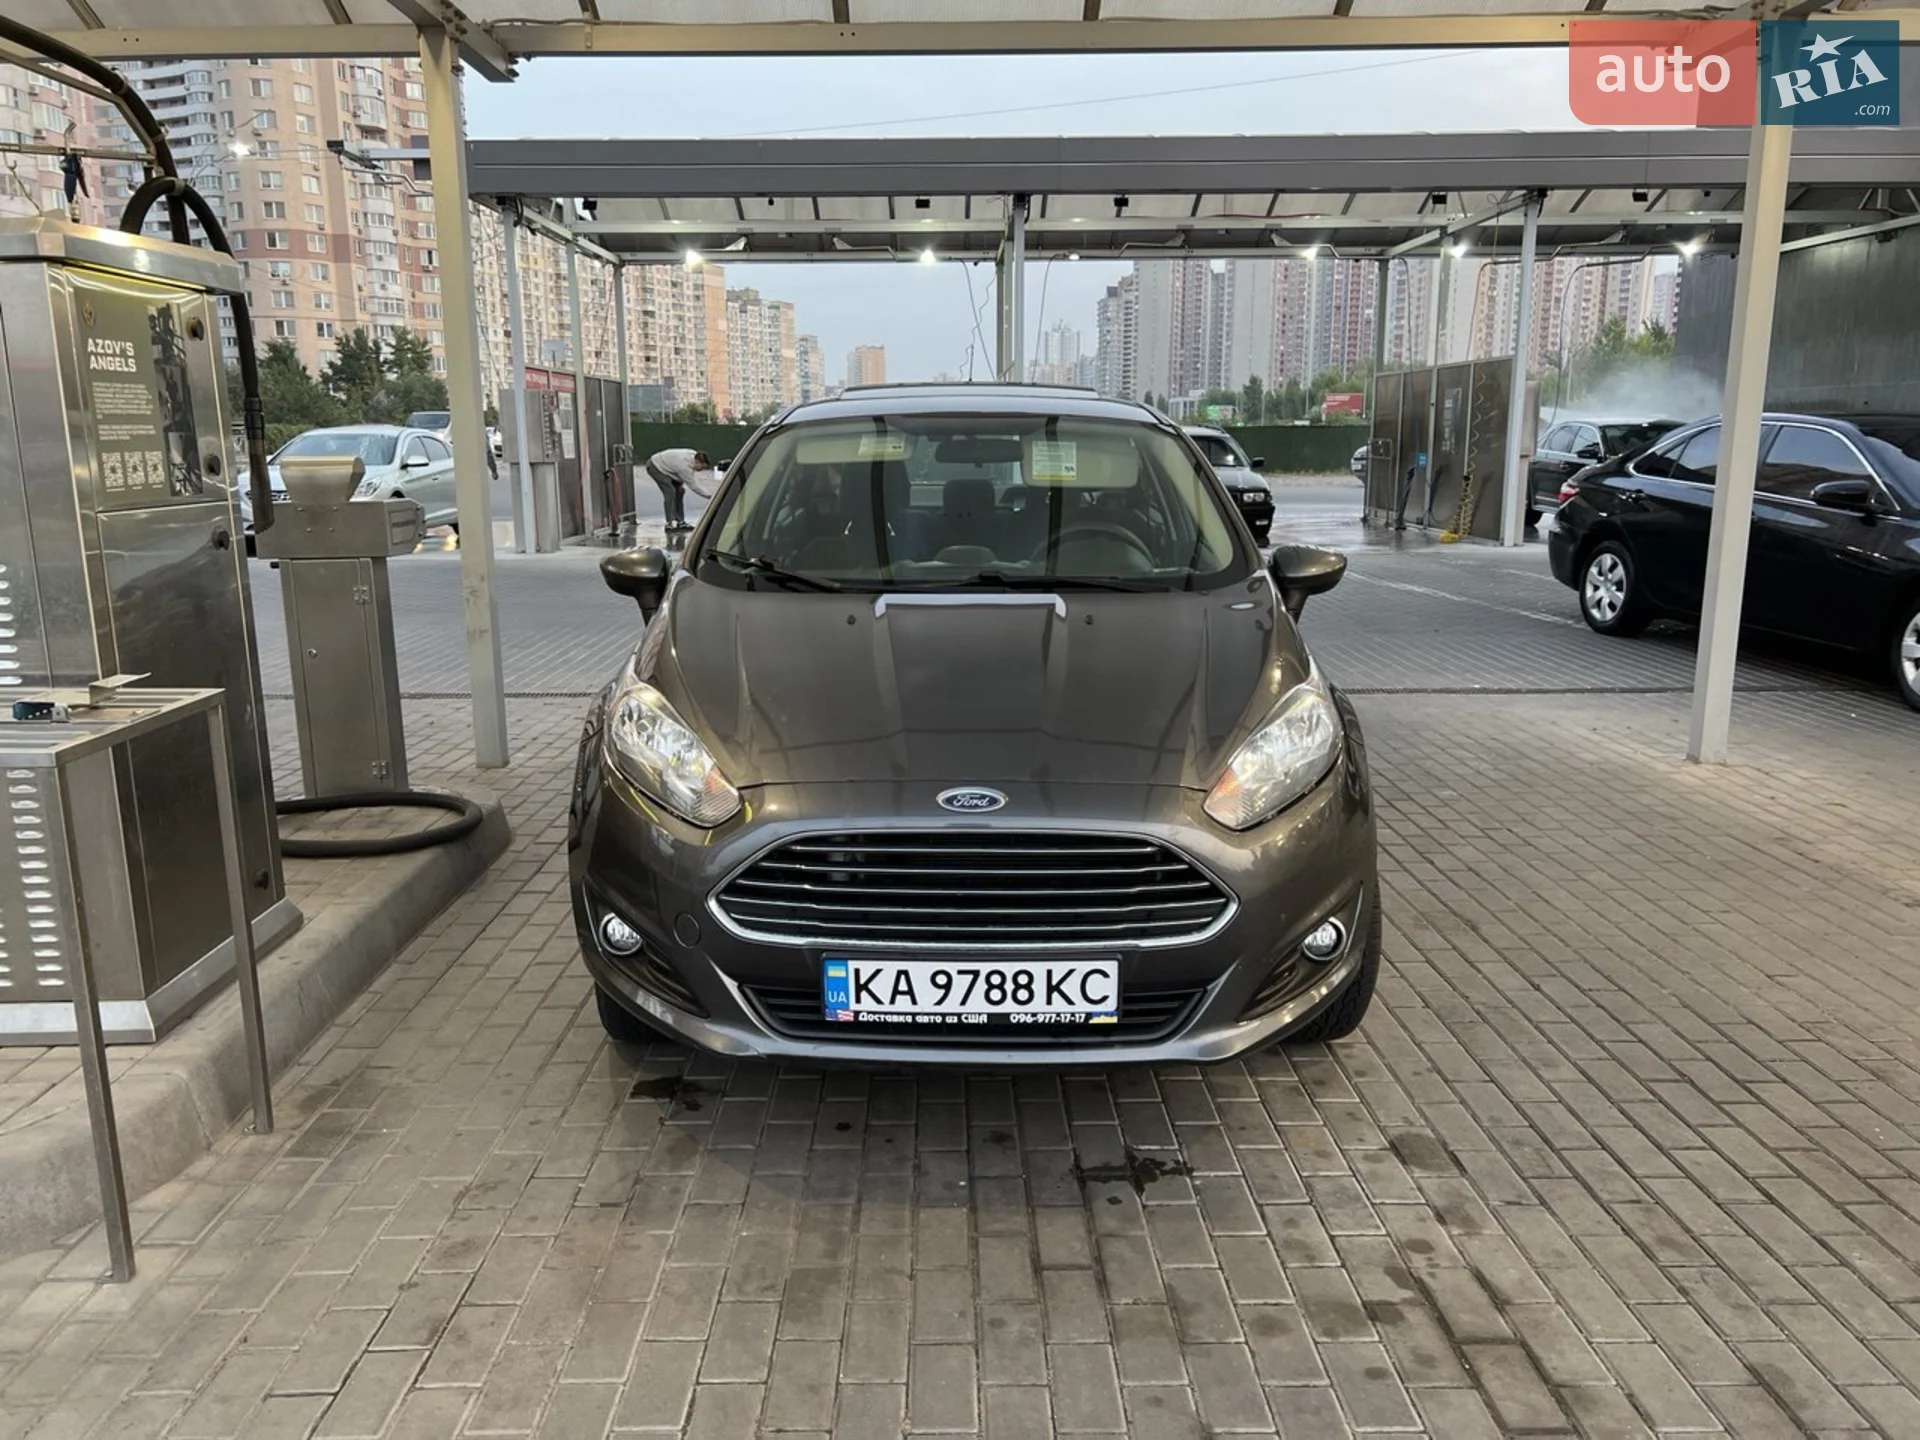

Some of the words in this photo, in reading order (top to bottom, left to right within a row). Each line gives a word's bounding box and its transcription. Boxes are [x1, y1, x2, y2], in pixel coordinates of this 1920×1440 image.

[87, 338, 135, 356] AZOV'S
[89, 355, 137, 373] ANGELS
[952, 794, 990, 807] Ford
[853, 967, 918, 1006] KA
[929, 968, 1035, 1007] 9788
[1045, 968, 1111, 1007] KC
[828, 991, 848, 1003] UA
[858, 1012, 913, 1023] Доставка
[915, 1014, 942, 1024] авто
[945, 1015, 958, 1024] из
[961, 1013, 988, 1024] США
[1009, 1013, 1087, 1024] 096-977-17-17
